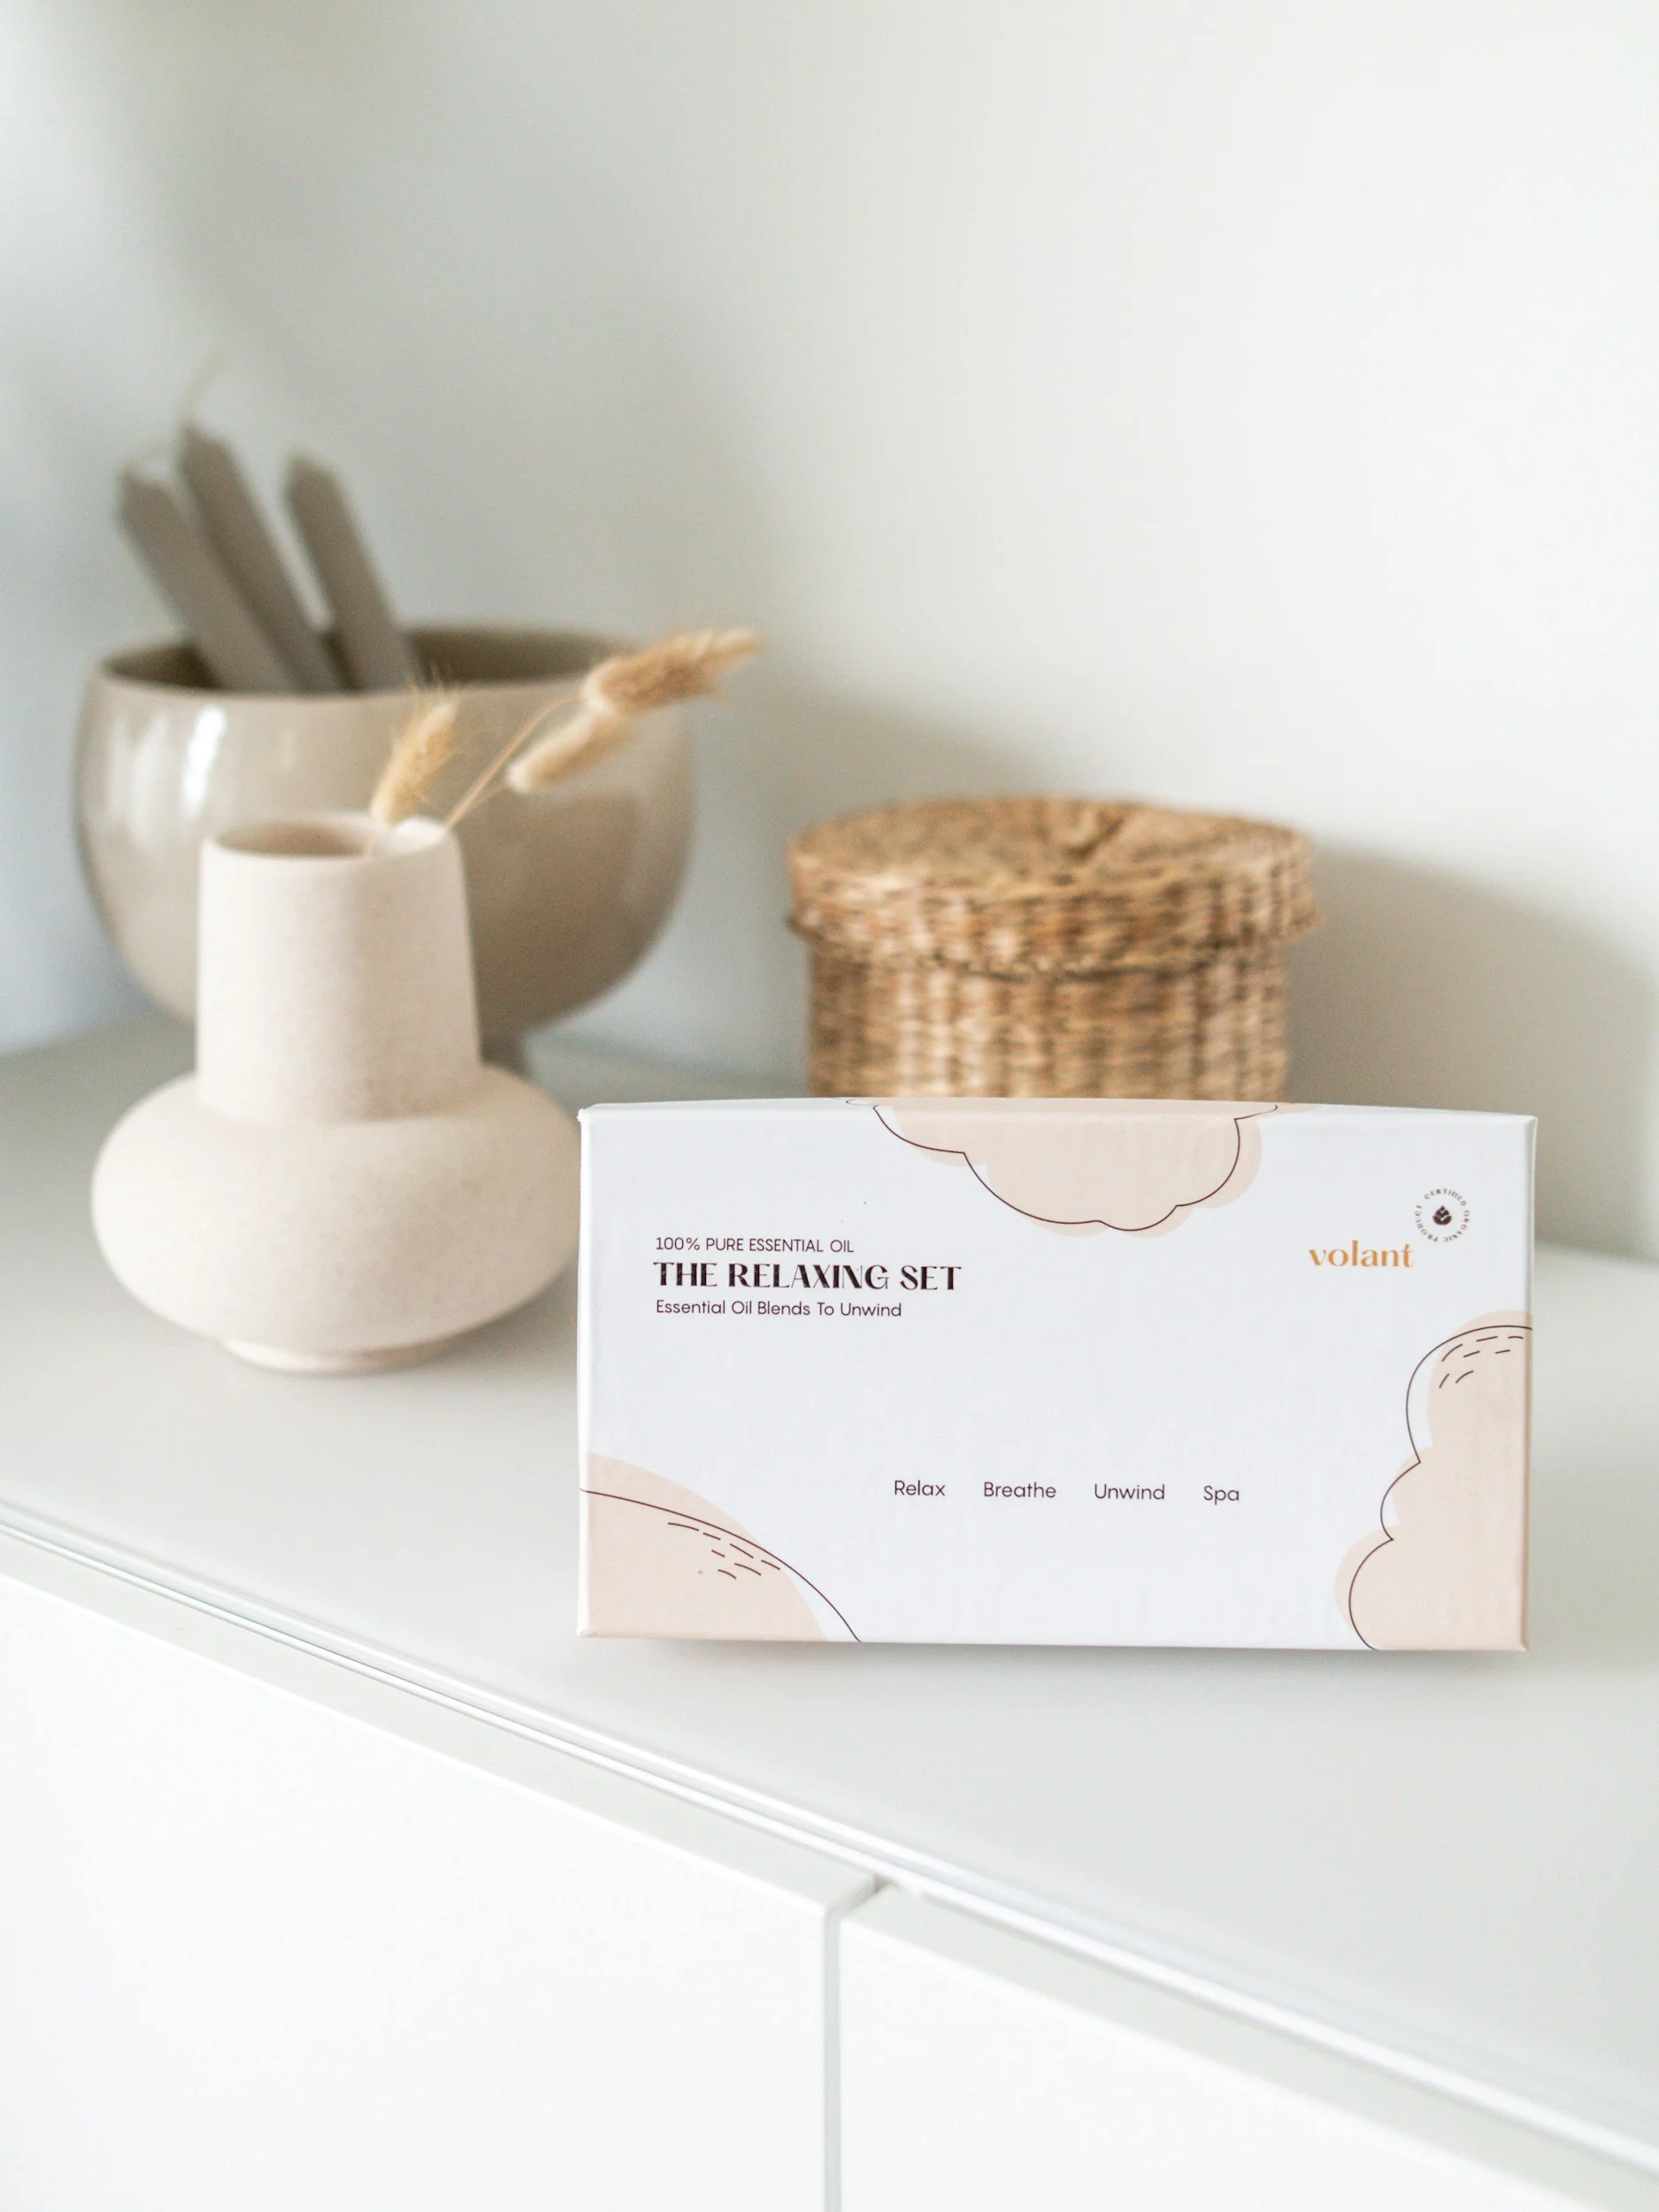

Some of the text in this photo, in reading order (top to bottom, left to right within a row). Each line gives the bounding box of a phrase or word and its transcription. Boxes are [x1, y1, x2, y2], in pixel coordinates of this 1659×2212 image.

[656, 1236, 855, 1254] 100% PURE ESSENTIAL OIL
[1309, 1240, 1414, 1268] volant
[653, 1261, 963, 1291] THE RELAXING SET
[656, 1299, 902, 1317] Essential Oil Blends To Unwind
[894, 1479, 1240, 1506] Relax Breathe Unwind Spa
